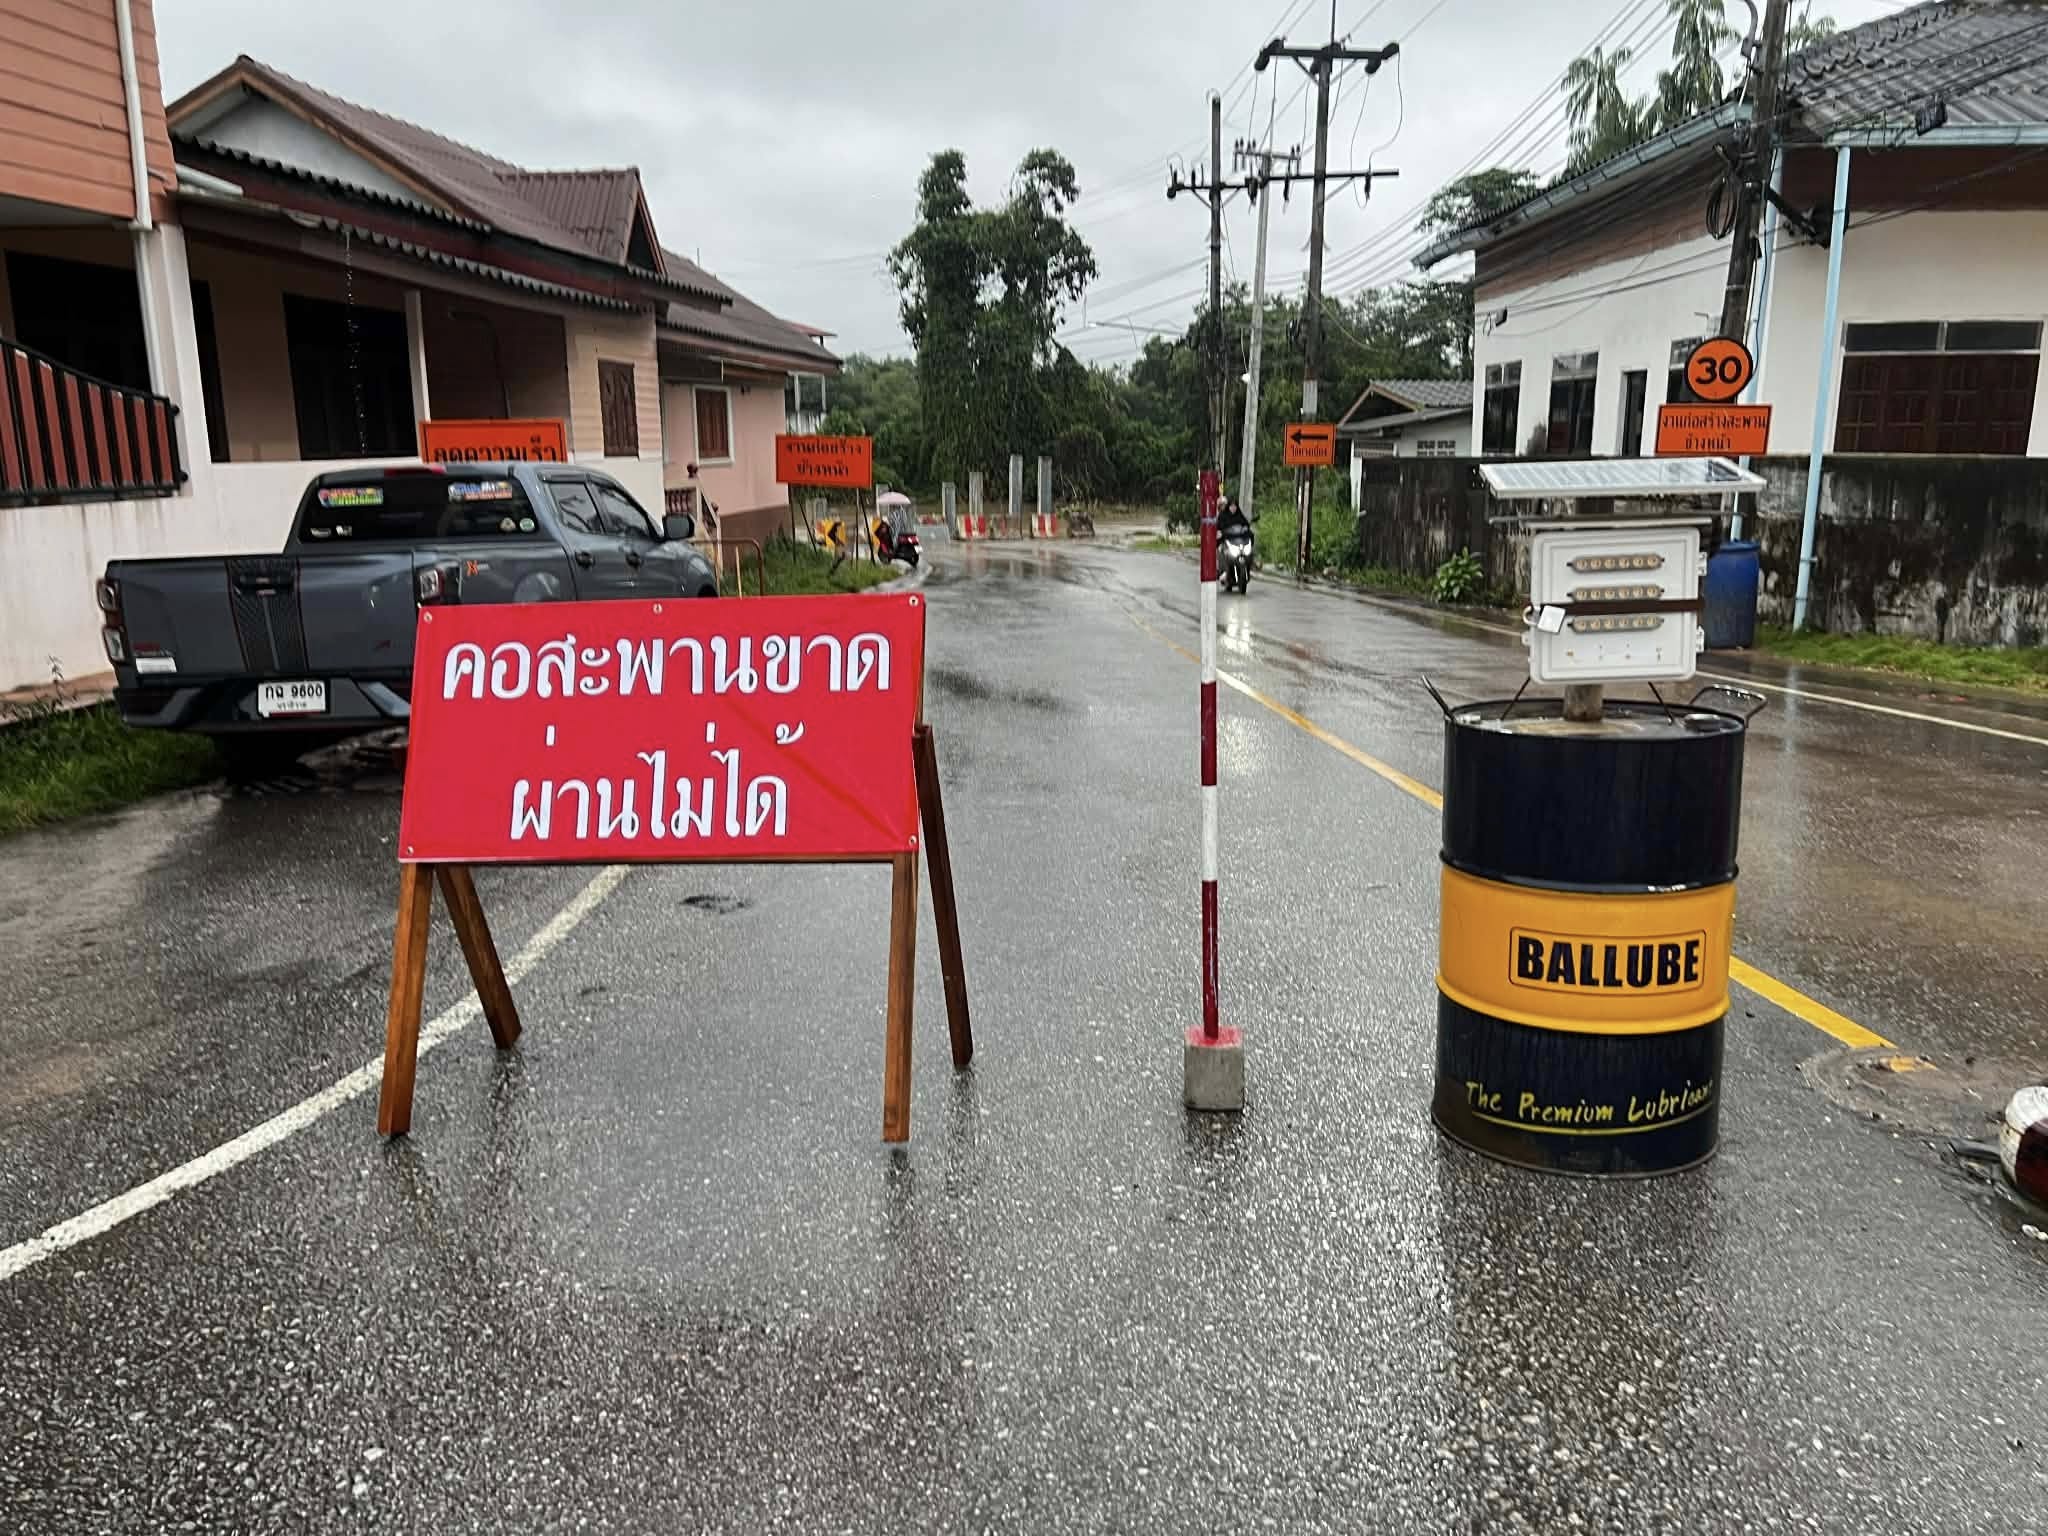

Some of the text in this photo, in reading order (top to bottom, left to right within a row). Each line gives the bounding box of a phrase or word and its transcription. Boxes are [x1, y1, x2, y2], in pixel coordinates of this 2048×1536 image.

[1695, 355, 1742, 385] 30
[1663, 411, 1767, 429] งานก่อสร้างสะพาน
[1685, 433, 1732, 450] ข้างหน้า
[443, 632, 892, 700] คอสะพานขาด
[509, 721, 805, 840] ผ่านไม่ได้
[1517, 935, 1701, 988] BALLUBE
[1465, 1080, 1501, 1113] The
[1518, 1092, 1614, 1123] Premium
